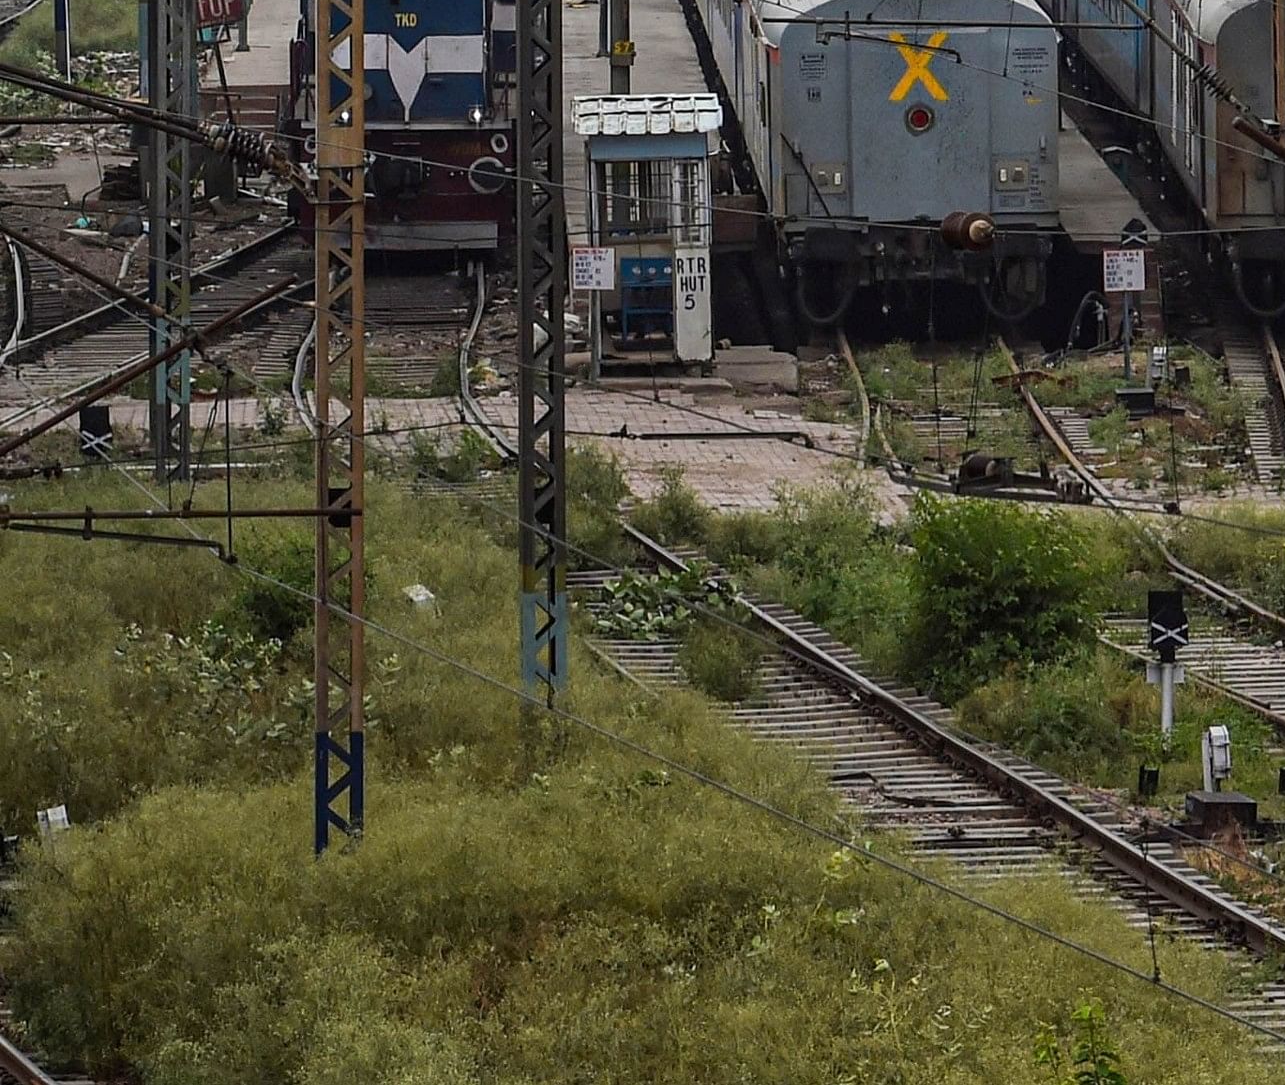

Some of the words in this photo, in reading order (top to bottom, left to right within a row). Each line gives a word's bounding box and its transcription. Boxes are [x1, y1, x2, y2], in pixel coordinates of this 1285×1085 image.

[395, 14, 417, 27] TKD
[677, 257, 707, 274] RTR
[681, 276, 706, 292] HUT
[685, 294, 696, 310] 5
